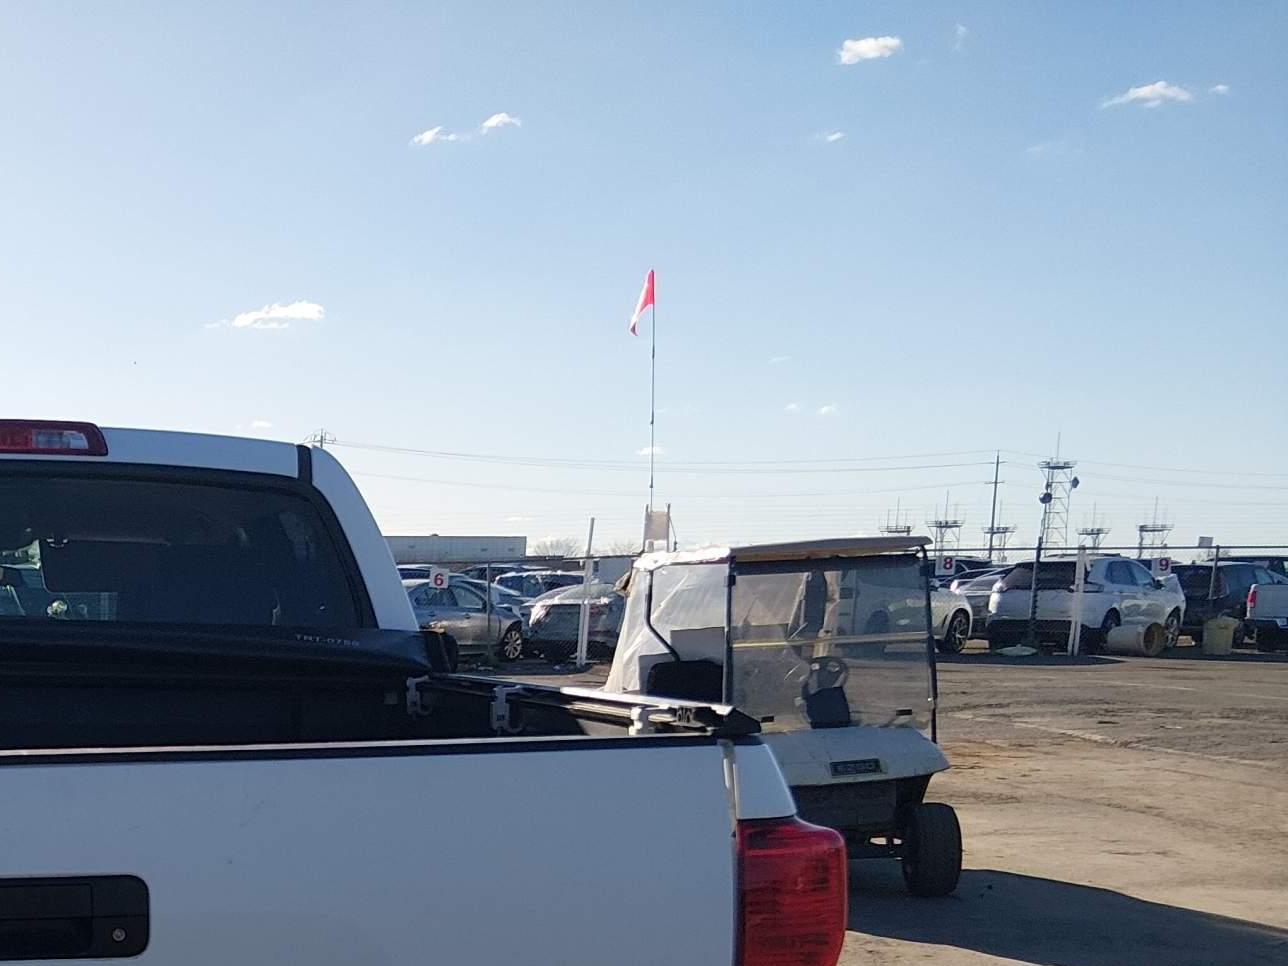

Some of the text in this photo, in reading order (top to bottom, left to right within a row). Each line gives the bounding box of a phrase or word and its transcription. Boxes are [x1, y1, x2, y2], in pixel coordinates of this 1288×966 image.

[943, 556, 953, 570] 8
[1159, 558, 1169, 571] 9
[434, 573, 444, 587] 6
